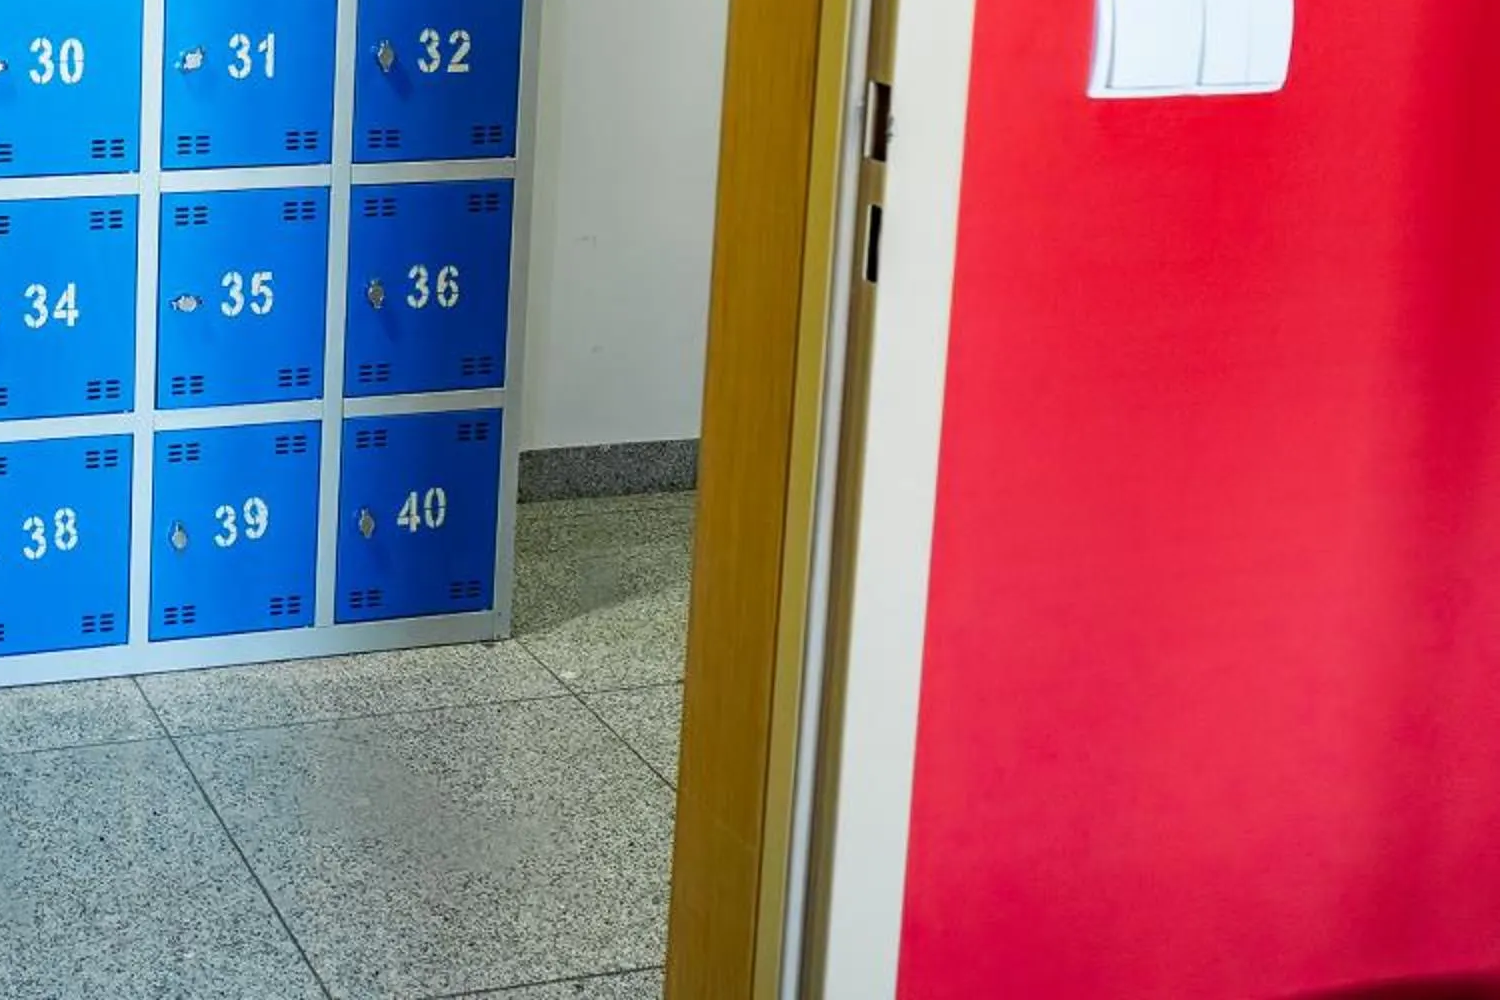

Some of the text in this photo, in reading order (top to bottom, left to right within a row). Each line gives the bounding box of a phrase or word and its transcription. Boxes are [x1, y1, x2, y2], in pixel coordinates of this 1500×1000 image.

[30, 38, 85, 84] 30
[228, 33, 276, 78] 31
[418, 29, 471, 73] 32
[24, 283, 80, 329] 34
[221, 271, 274, 316] 35
[407, 265, 459, 309] 36
[215, 497, 269, 547] 39
[397, 487, 446, 532] 40
[23, 508, 78, 559] 38
